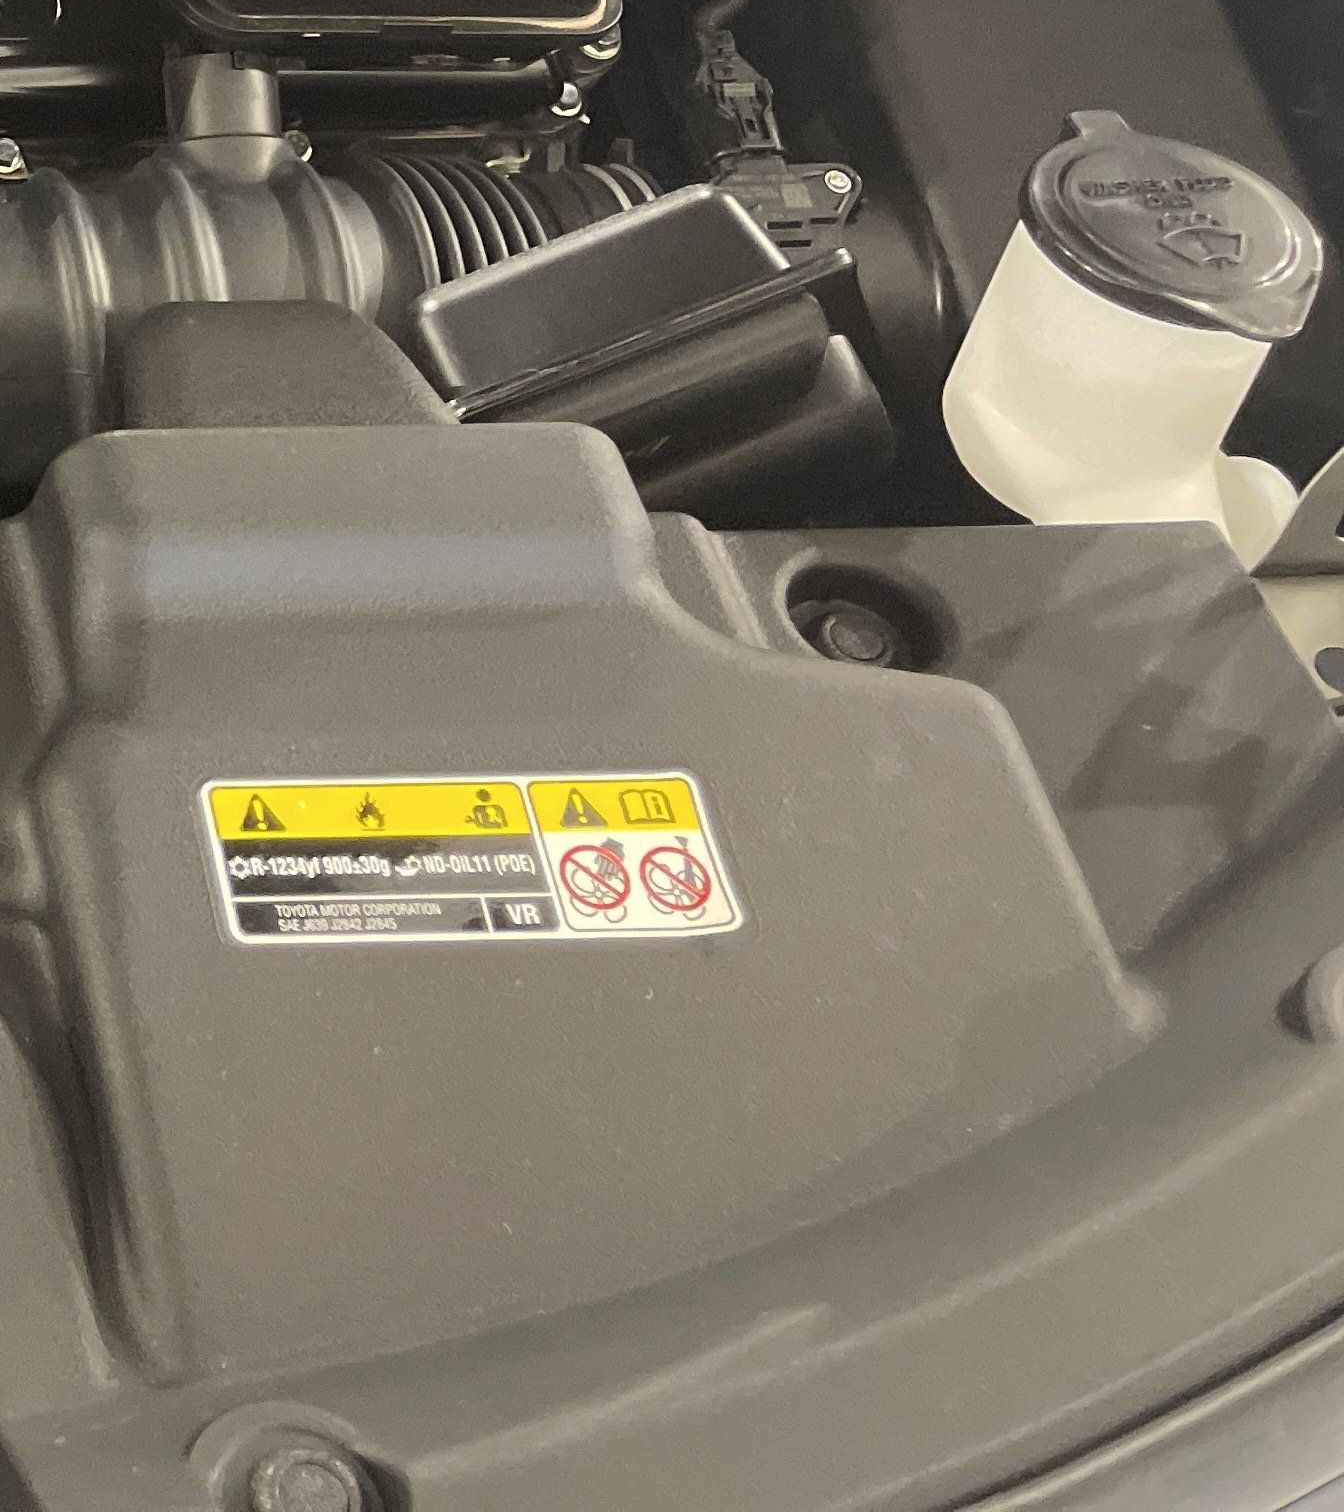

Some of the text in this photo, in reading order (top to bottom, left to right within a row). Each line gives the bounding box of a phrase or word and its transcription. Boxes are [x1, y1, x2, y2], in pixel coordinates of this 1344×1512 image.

[249, 854, 537, 879] R-1234yf 900±30g ND-OIL11 (POE)
[274, 902, 442, 918] TOYOTA MOTOR CORPORATION
[504, 902, 542, 926] VR
[277, 918, 302, 932] SAE
[302, 918, 329, 931] J639
